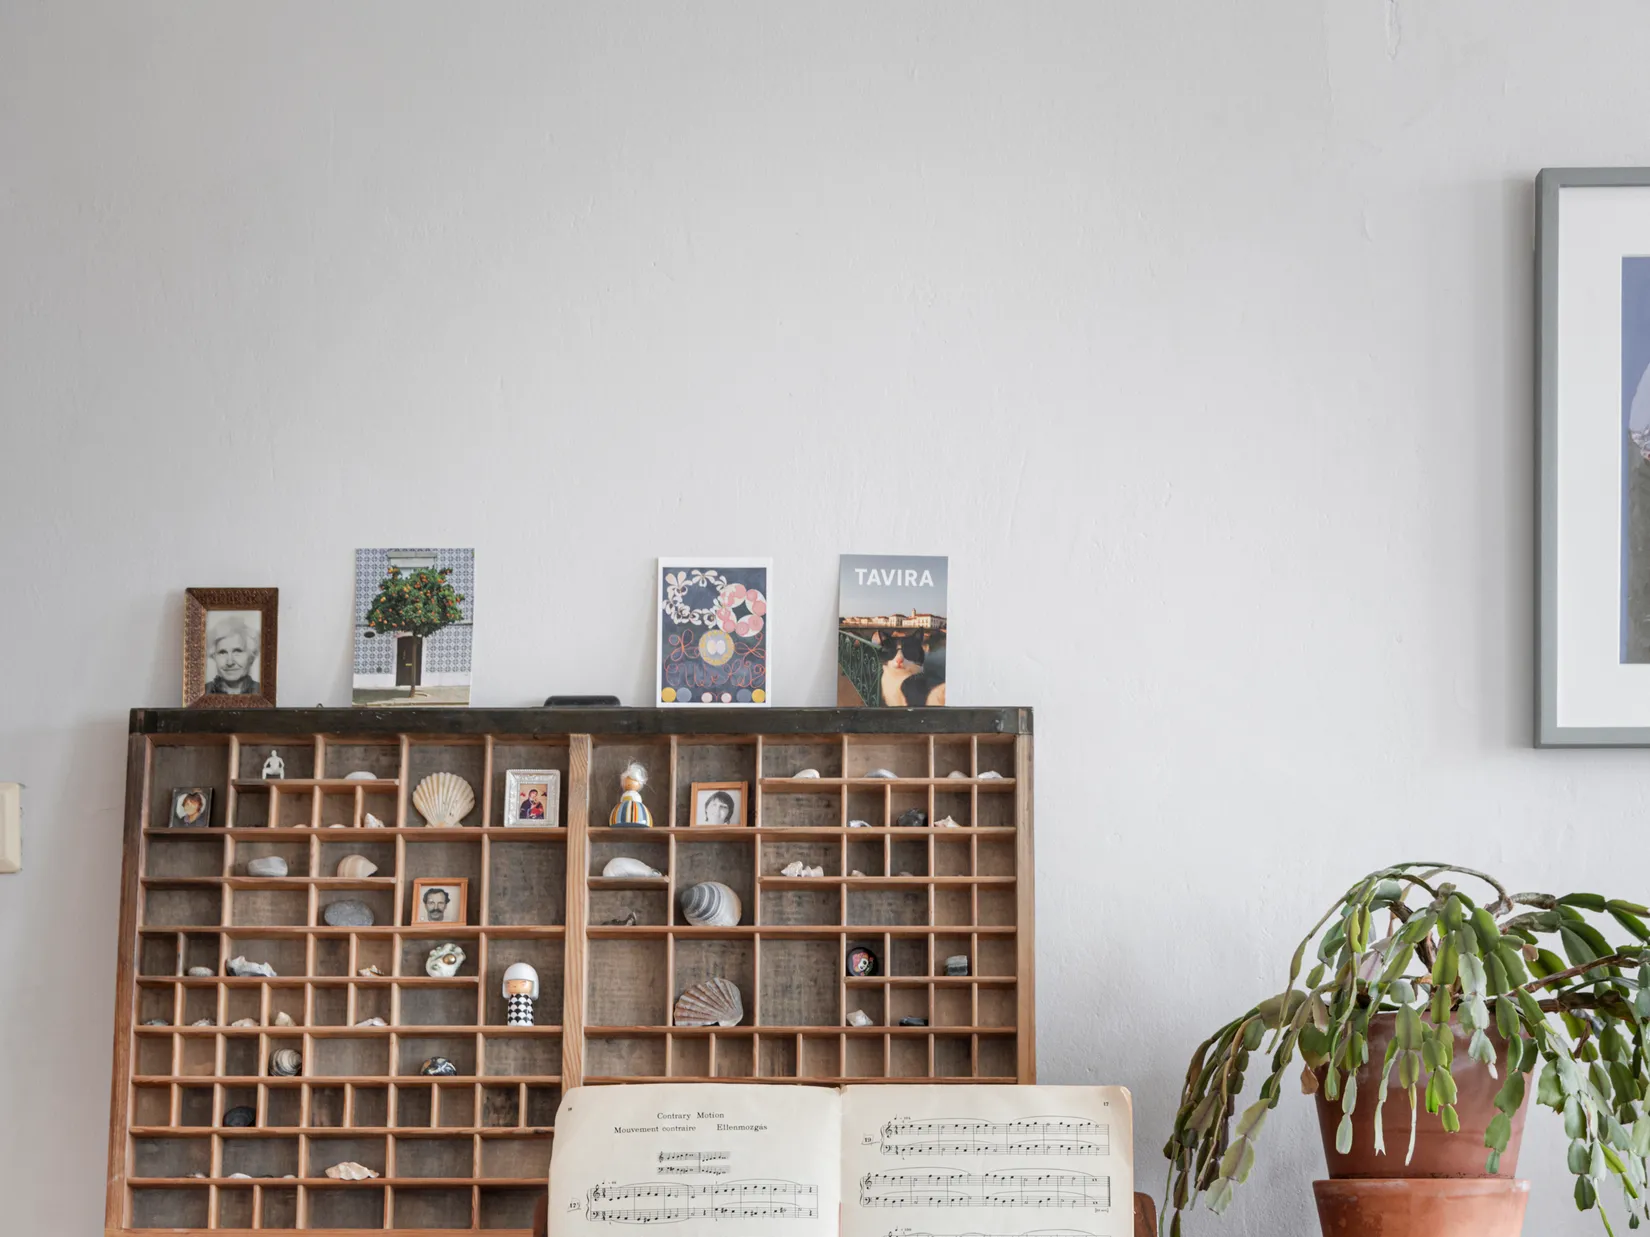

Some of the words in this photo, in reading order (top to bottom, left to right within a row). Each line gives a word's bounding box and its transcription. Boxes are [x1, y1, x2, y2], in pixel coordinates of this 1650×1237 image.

[854, 568, 934, 587] TAVIRA
[657, 1112, 691, 1121] Contrary
[697, 1111, 725, 1119] Motion
[614, 1126, 659, 1134] Mouvement
[662, 1124, 697, 1133] contraire
[716, 1123, 768, 1132] Ellenmozgás
